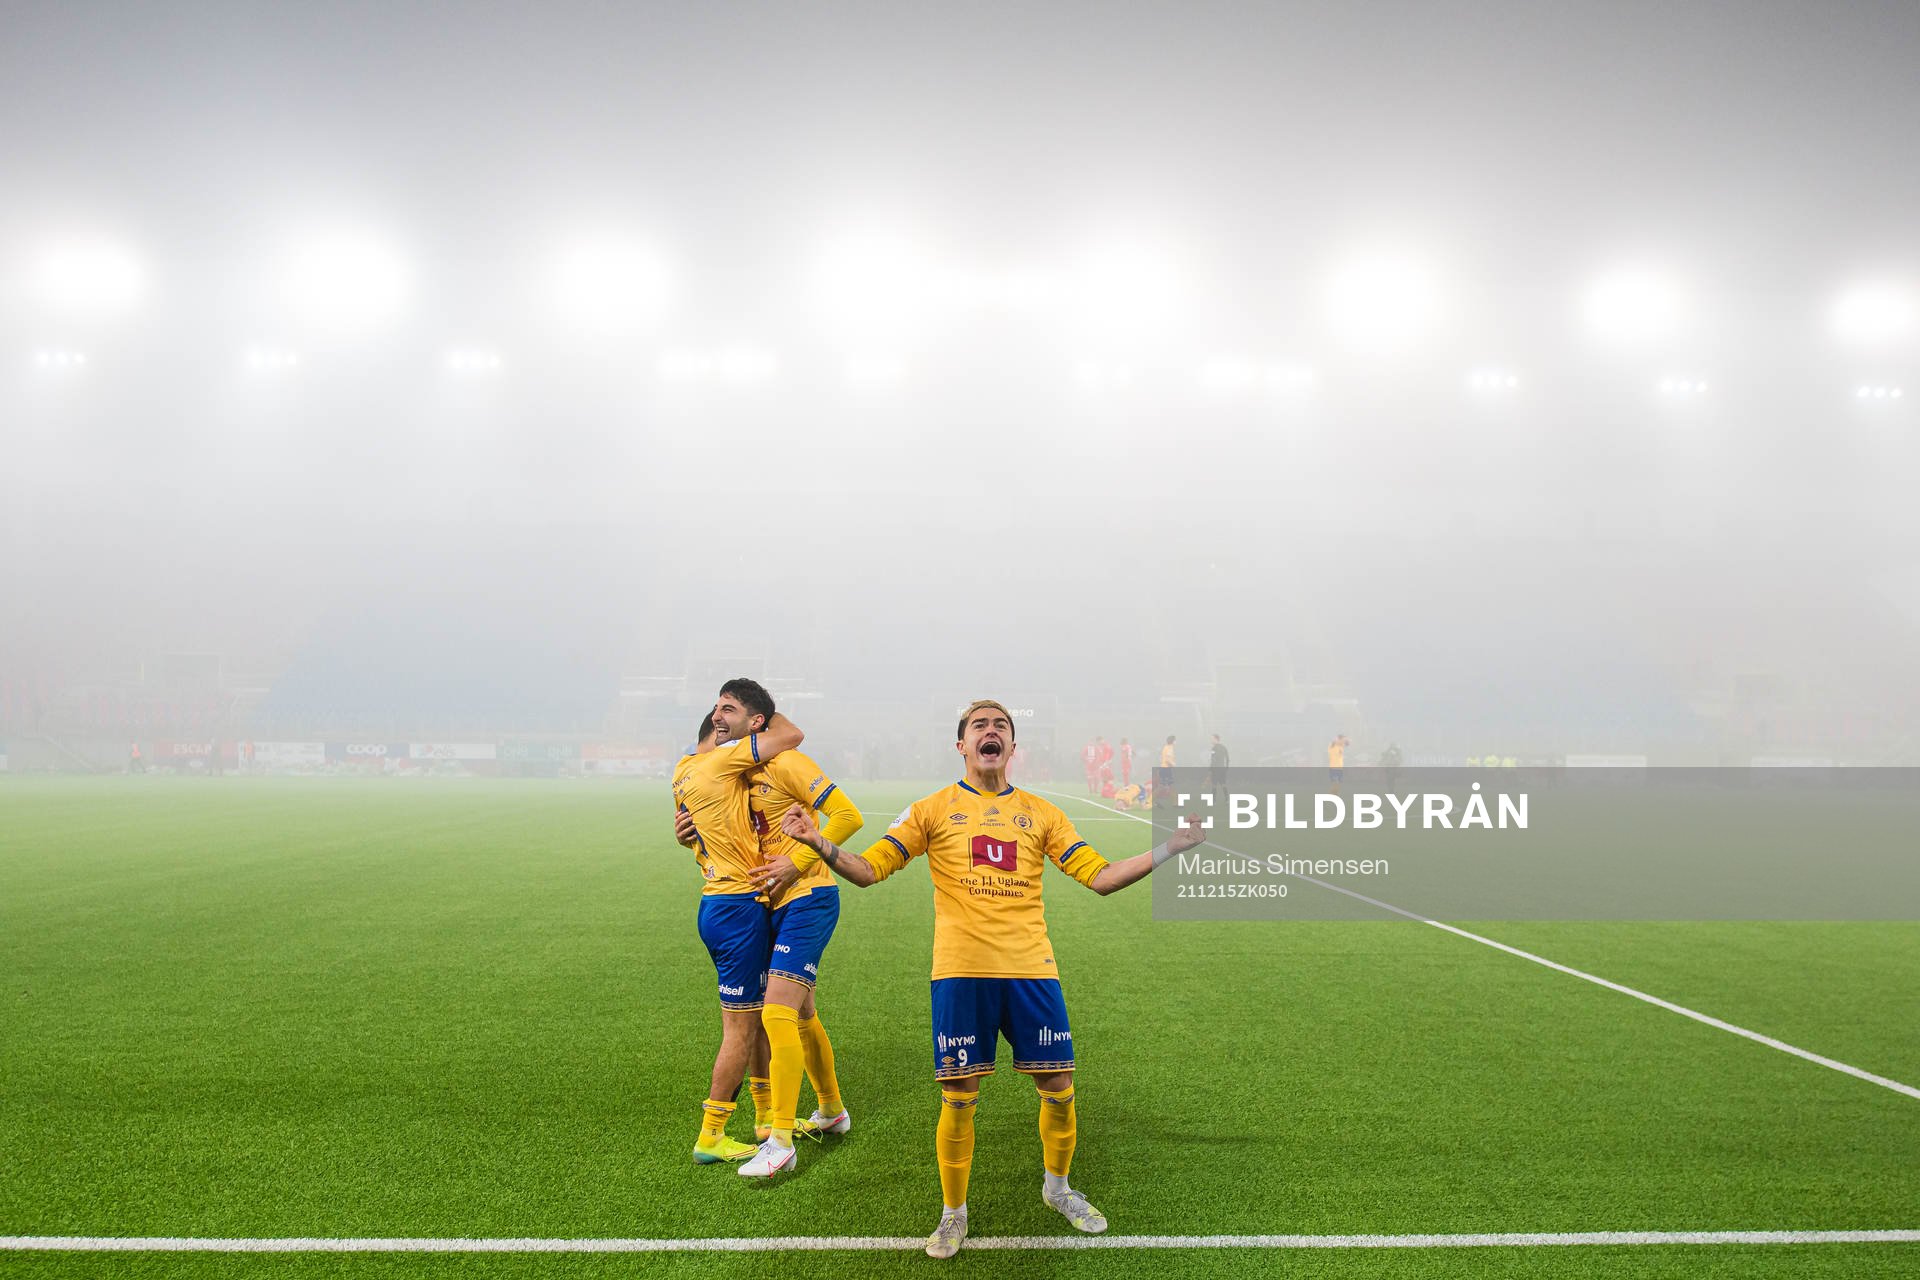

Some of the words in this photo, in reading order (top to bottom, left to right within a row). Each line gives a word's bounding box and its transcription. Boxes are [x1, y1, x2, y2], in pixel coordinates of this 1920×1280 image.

[1009, 708, 1034, 717] rena
[173, 743, 213, 755] ESCAP
[346, 744, 388, 757] coop
[987, 844, 1003, 862] U
[774, 943, 790, 954] YMO
[948, 1035, 976, 1048] NYMO
[1054, 1031, 1072, 1042] NYM
[957, 1049, 968, 1067] 9
